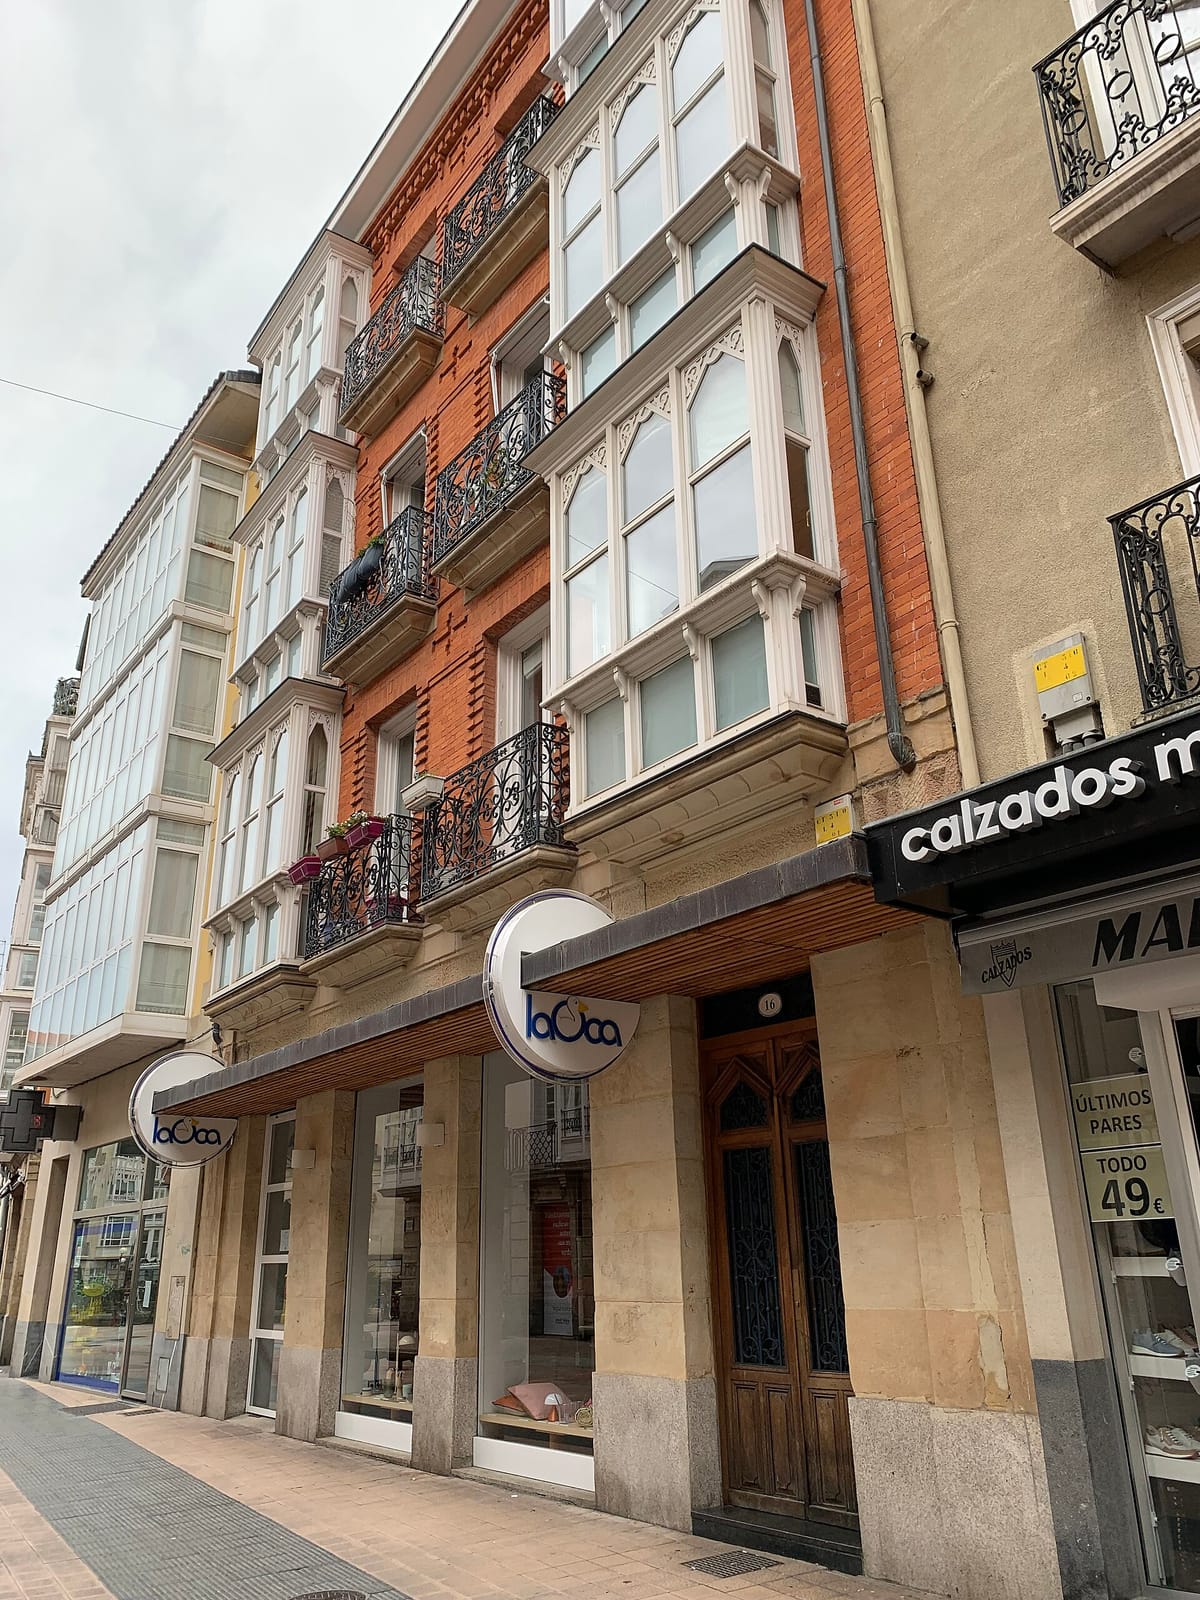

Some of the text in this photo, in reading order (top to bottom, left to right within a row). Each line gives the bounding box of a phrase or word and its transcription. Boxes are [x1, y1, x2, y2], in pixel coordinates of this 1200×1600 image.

[901, 757, 1144, 861] calzados
[981, 946, 1032, 983] CALZADOS
[765, 998, 775, 1011] 16
[1075, 1089, 1151, 1113] ÚLTIMOS
[1090, 1114, 1142, 1134] PARES
[1096, 1155, 1147, 1174] TODO
